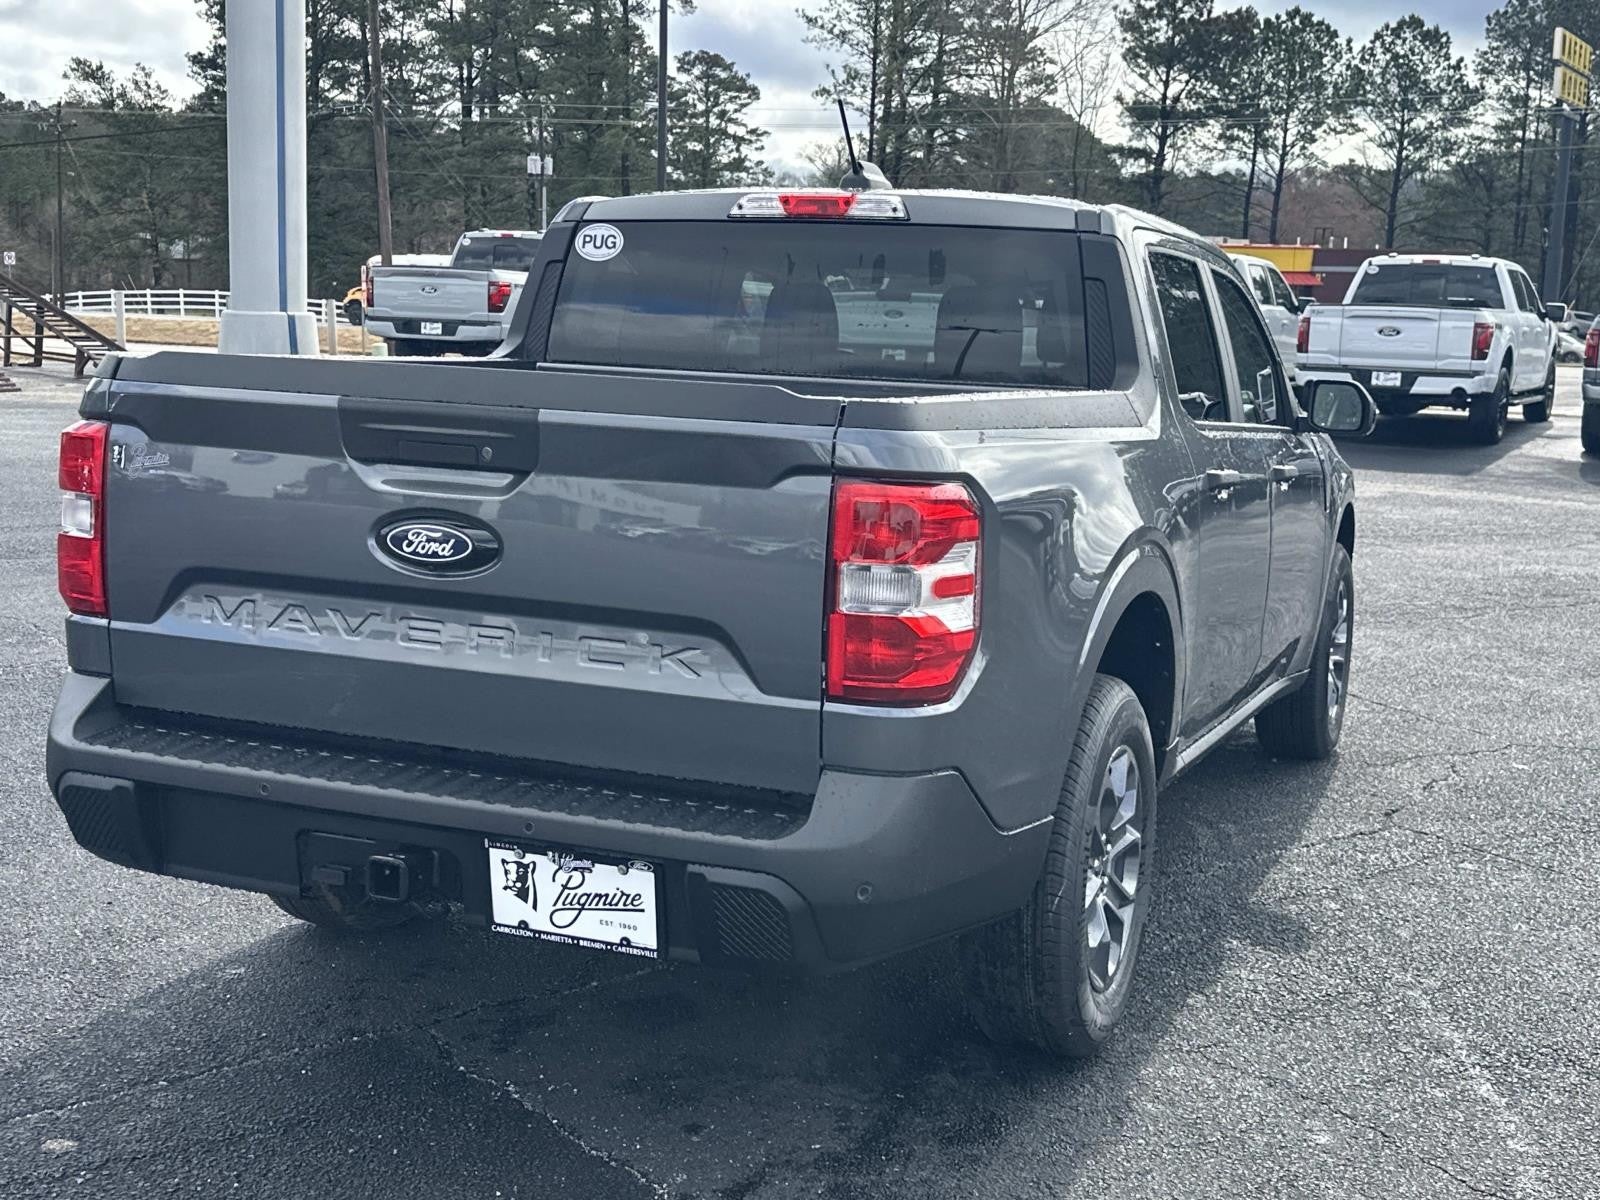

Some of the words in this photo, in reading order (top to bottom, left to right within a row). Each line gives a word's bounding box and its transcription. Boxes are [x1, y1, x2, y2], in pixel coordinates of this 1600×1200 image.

[582, 234, 617, 250] PUG
[402, 529, 455, 556] Ford
[201, 595, 703, 679] MAVERICK
[550, 868, 645, 929] Pugmire
[540, 933, 573, 944] MARIETTA
[579, 939, 606, 950] BREMEN
[612, 945, 658, 959] CARTERSVILLE
